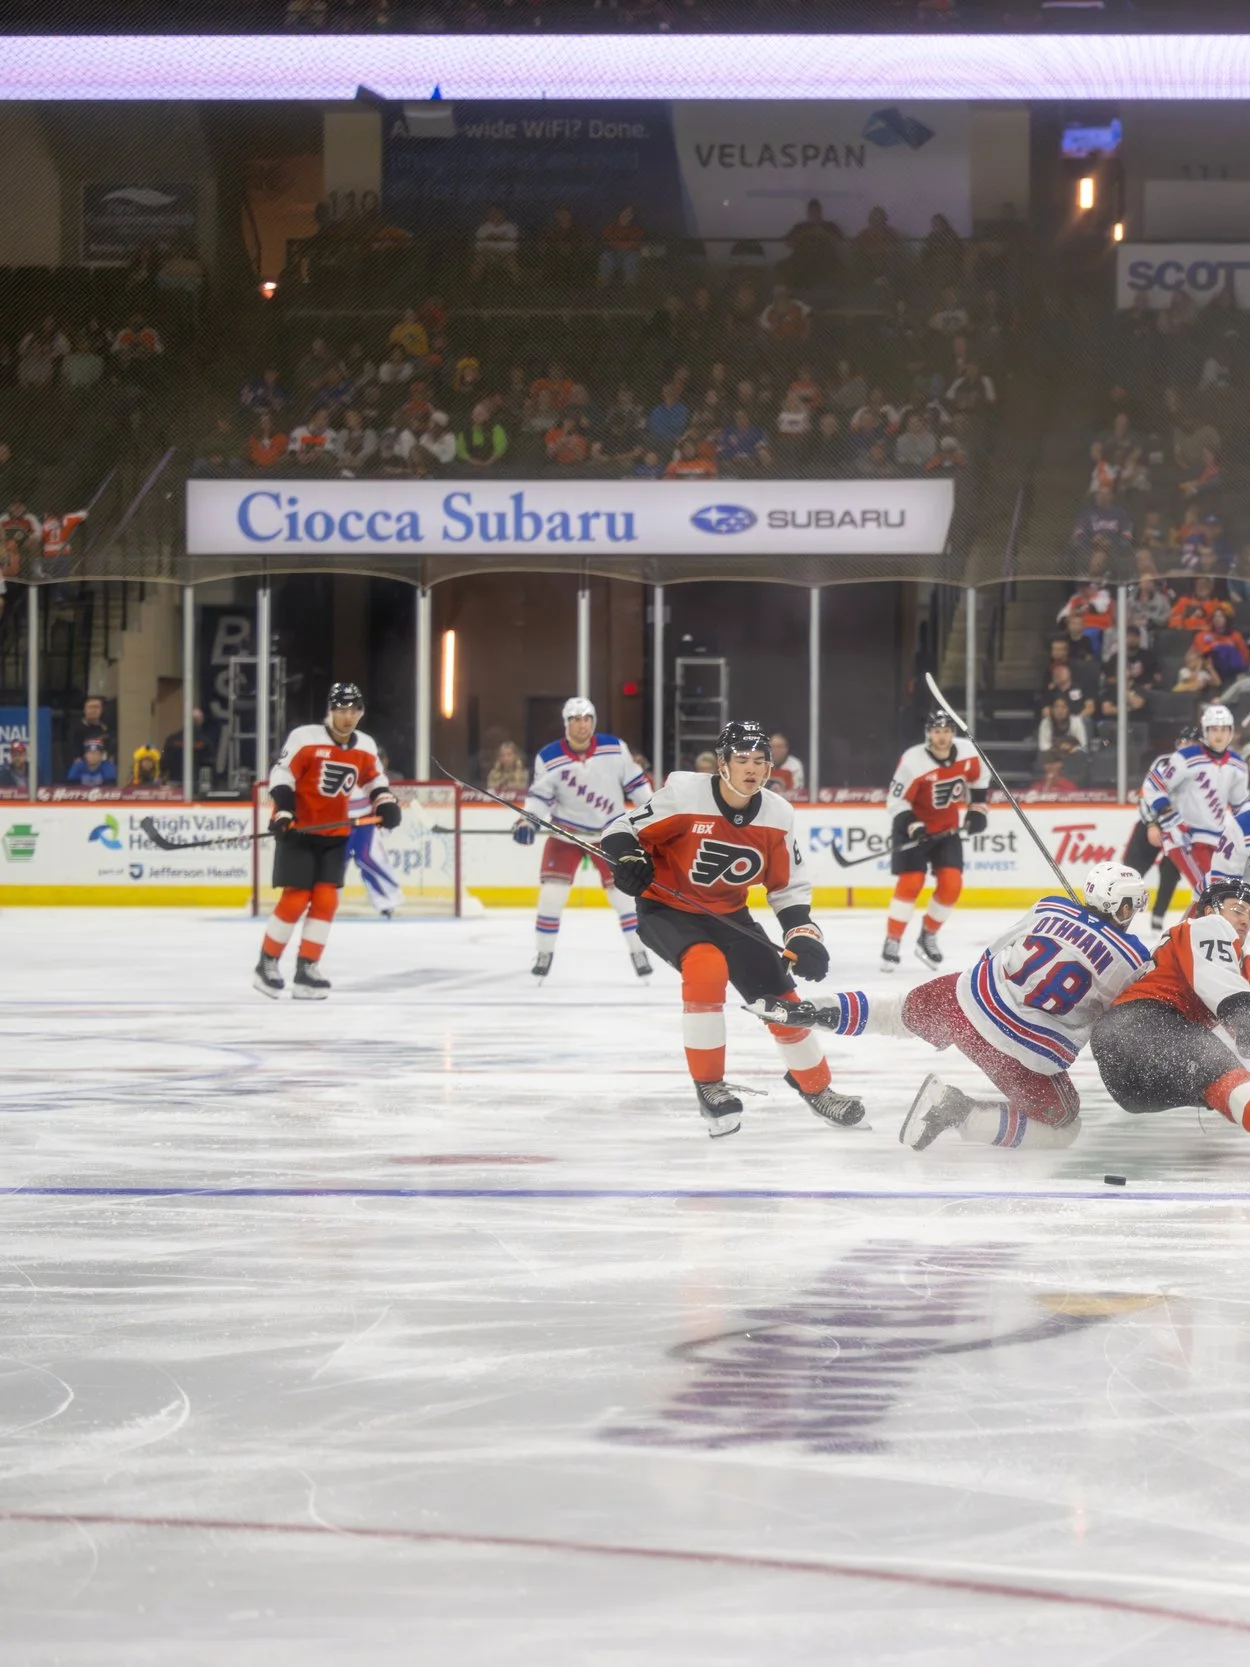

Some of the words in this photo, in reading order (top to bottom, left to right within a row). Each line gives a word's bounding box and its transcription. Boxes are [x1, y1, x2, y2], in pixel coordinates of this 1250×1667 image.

[522, 119, 582, 139] WiFi?
[588, 119, 650, 139] Done.
[695, 142, 866, 169] VELASPAN
[237, 491, 423, 543] Ciocca
[442, 491, 638, 543] Subaru
[767, 508, 905, 529] SUBARU
[193, 815, 249, 834] Valley
[691, 823, 714, 835] IBX
[130, 834, 187, 850] Helth
[1052, 823, 1116, 865] Tim
[1216, 835, 1234, 860] 94
[149, 866, 204, 880] Jefferson
[207, 865, 248, 879] Health
[1086, 881, 1095, 893] 78
[1032, 916, 1114, 975] OTHMANN
[1200, 939, 1233, 962] 75
[1004, 935, 1092, 1016] 78
